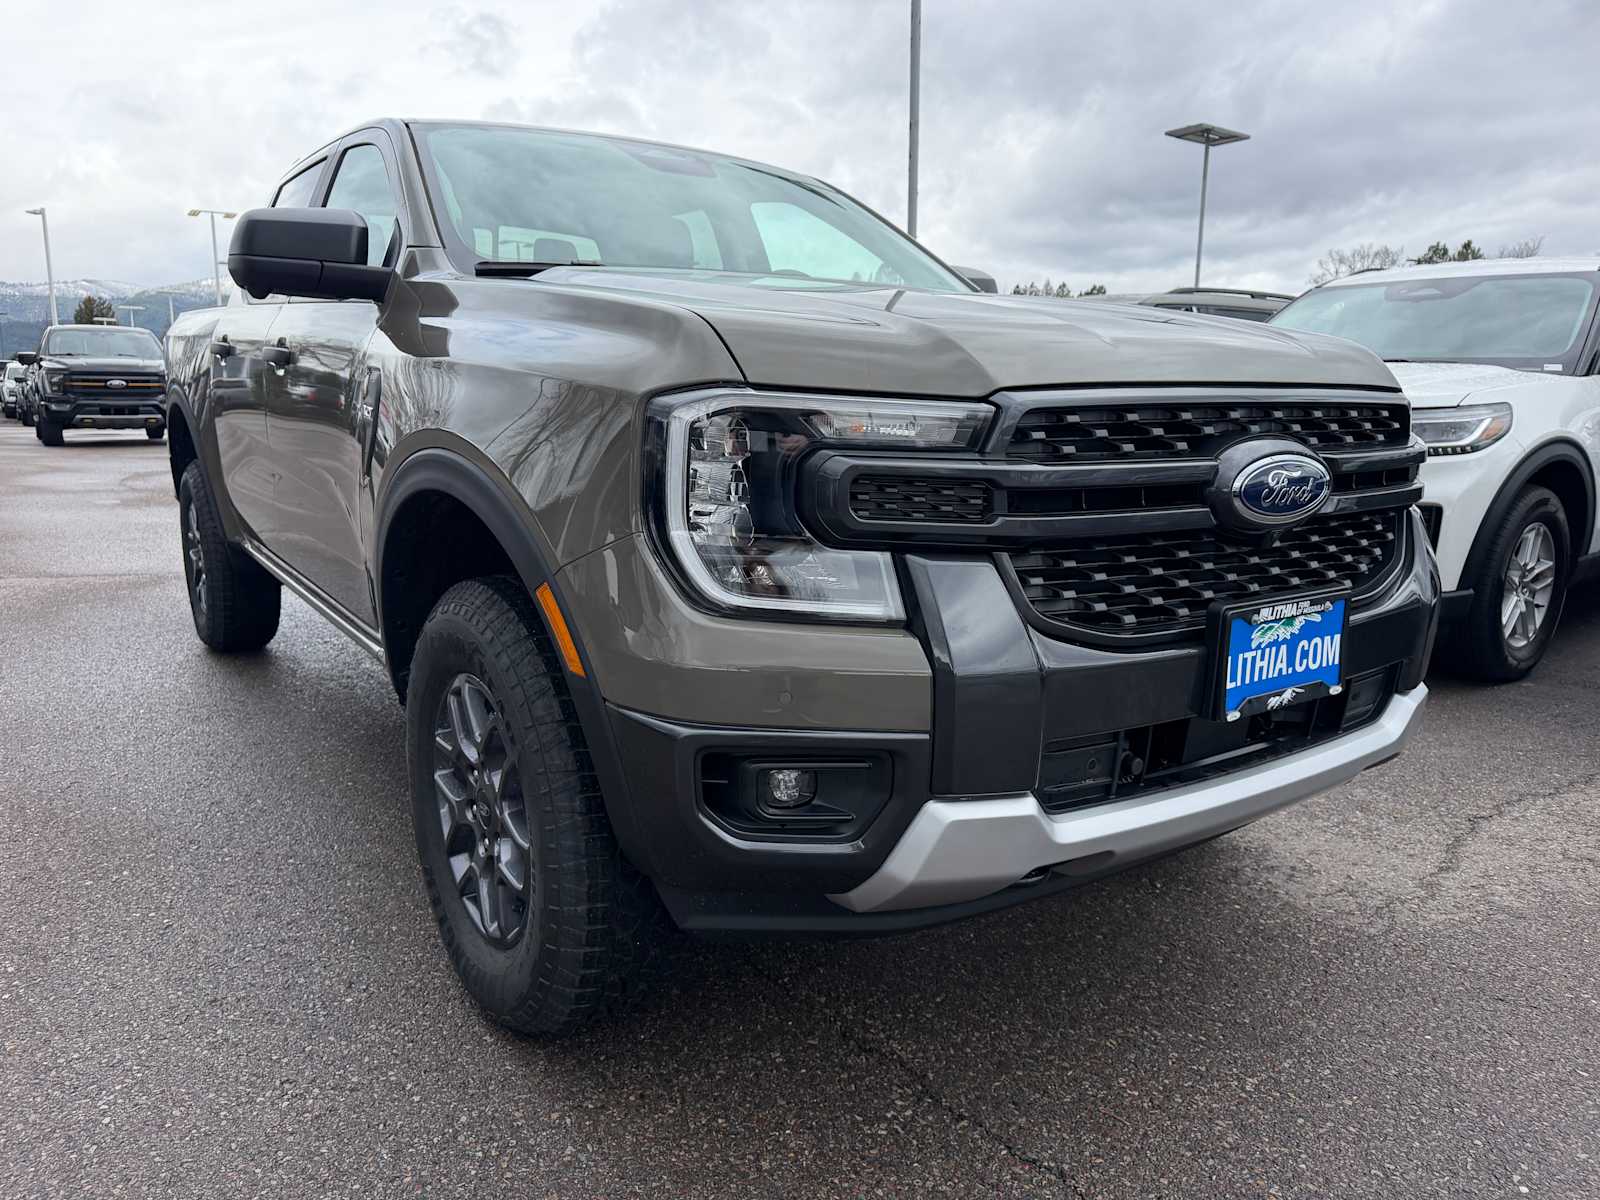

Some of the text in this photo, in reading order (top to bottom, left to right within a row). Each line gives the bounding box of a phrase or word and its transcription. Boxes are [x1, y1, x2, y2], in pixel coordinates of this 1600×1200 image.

[1261, 470, 1314, 507] Ford
[1269, 603, 1298, 621] LITHIA
[1226, 633, 1341, 690] LITHIA.COM
